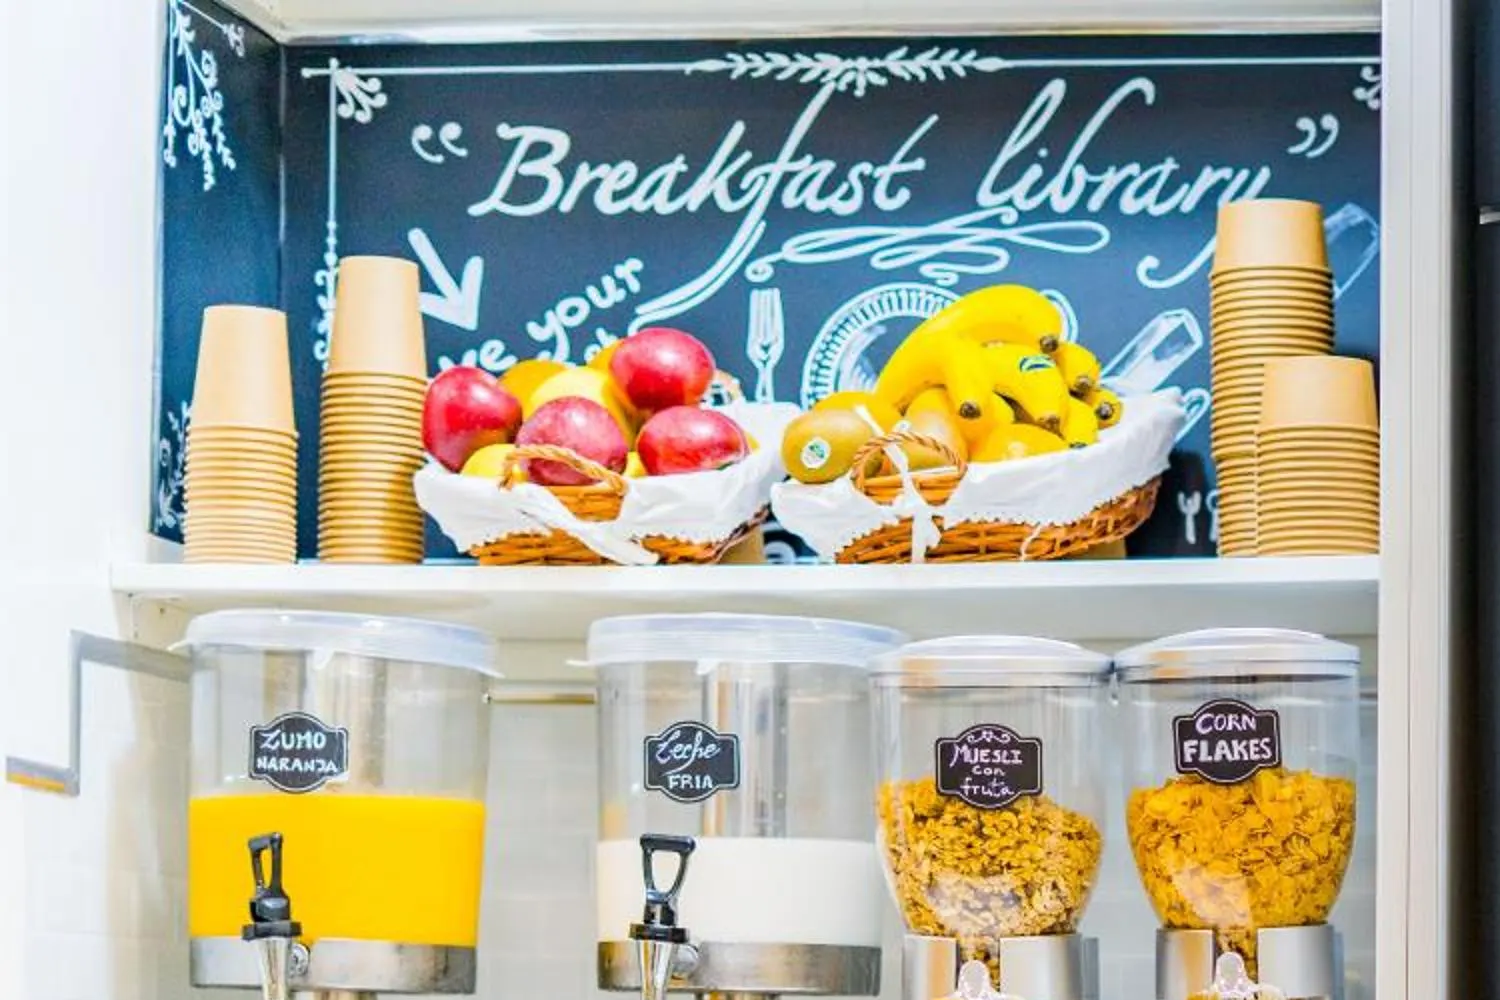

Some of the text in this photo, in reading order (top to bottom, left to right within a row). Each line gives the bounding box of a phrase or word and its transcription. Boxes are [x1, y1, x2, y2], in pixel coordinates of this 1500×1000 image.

[525, 257, 644, 364] your
[1195, 712, 1258, 735] CORN
[259, 729, 327, 750] ZUMO
[1183, 737, 1274, 763] FLAKES
[255, 756, 340, 773] NARANJA
[667, 773, 713, 790] FRIA
